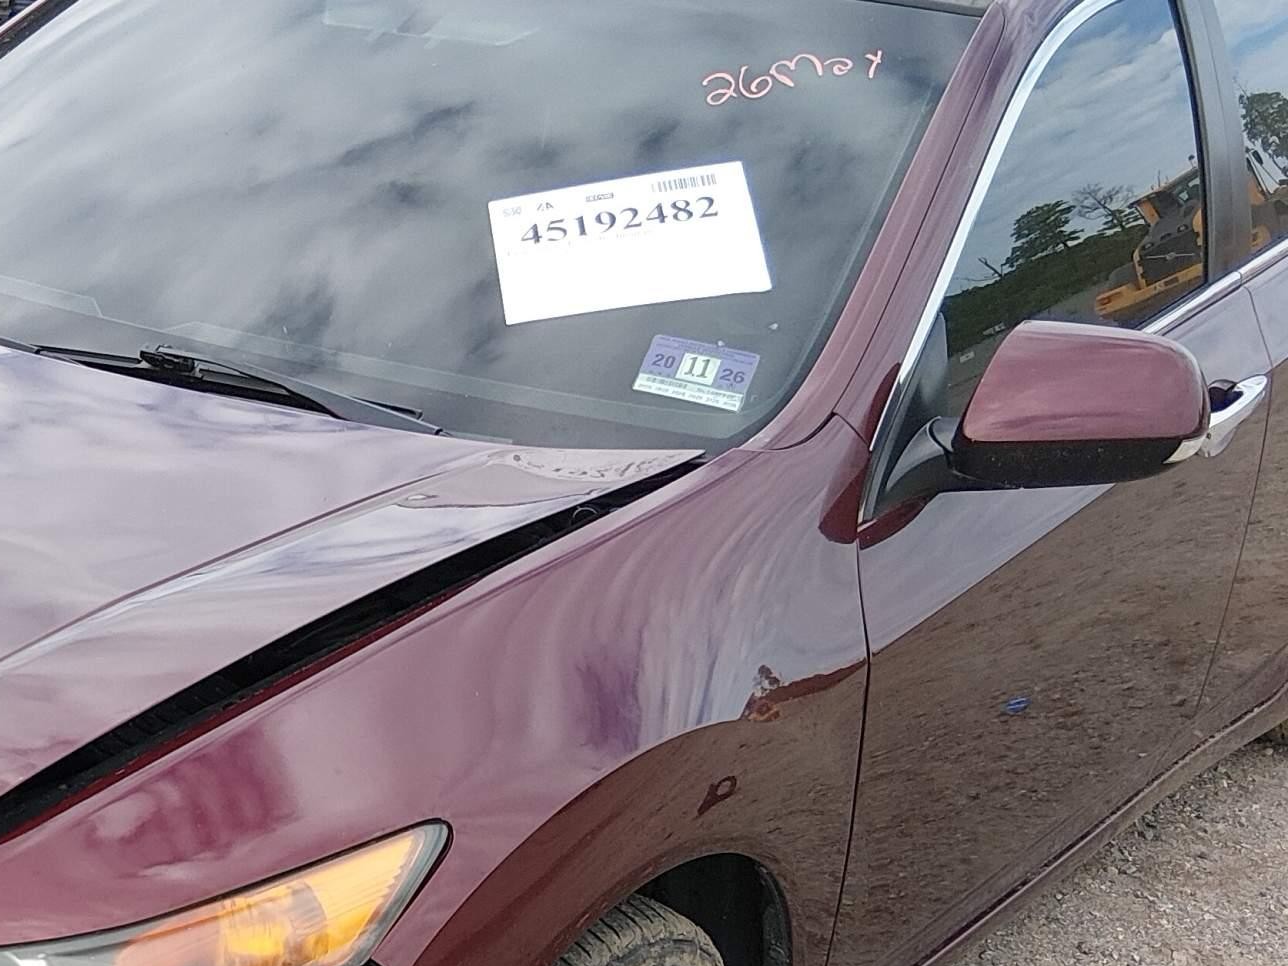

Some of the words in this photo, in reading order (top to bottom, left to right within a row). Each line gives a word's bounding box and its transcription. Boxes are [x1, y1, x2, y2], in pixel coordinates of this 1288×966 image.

[520, 195, 719, 244] 45192482
[651, 352, 677, 369] 20
[683, 356, 711, 379] 11
[719, 368, 745, 384] 26
